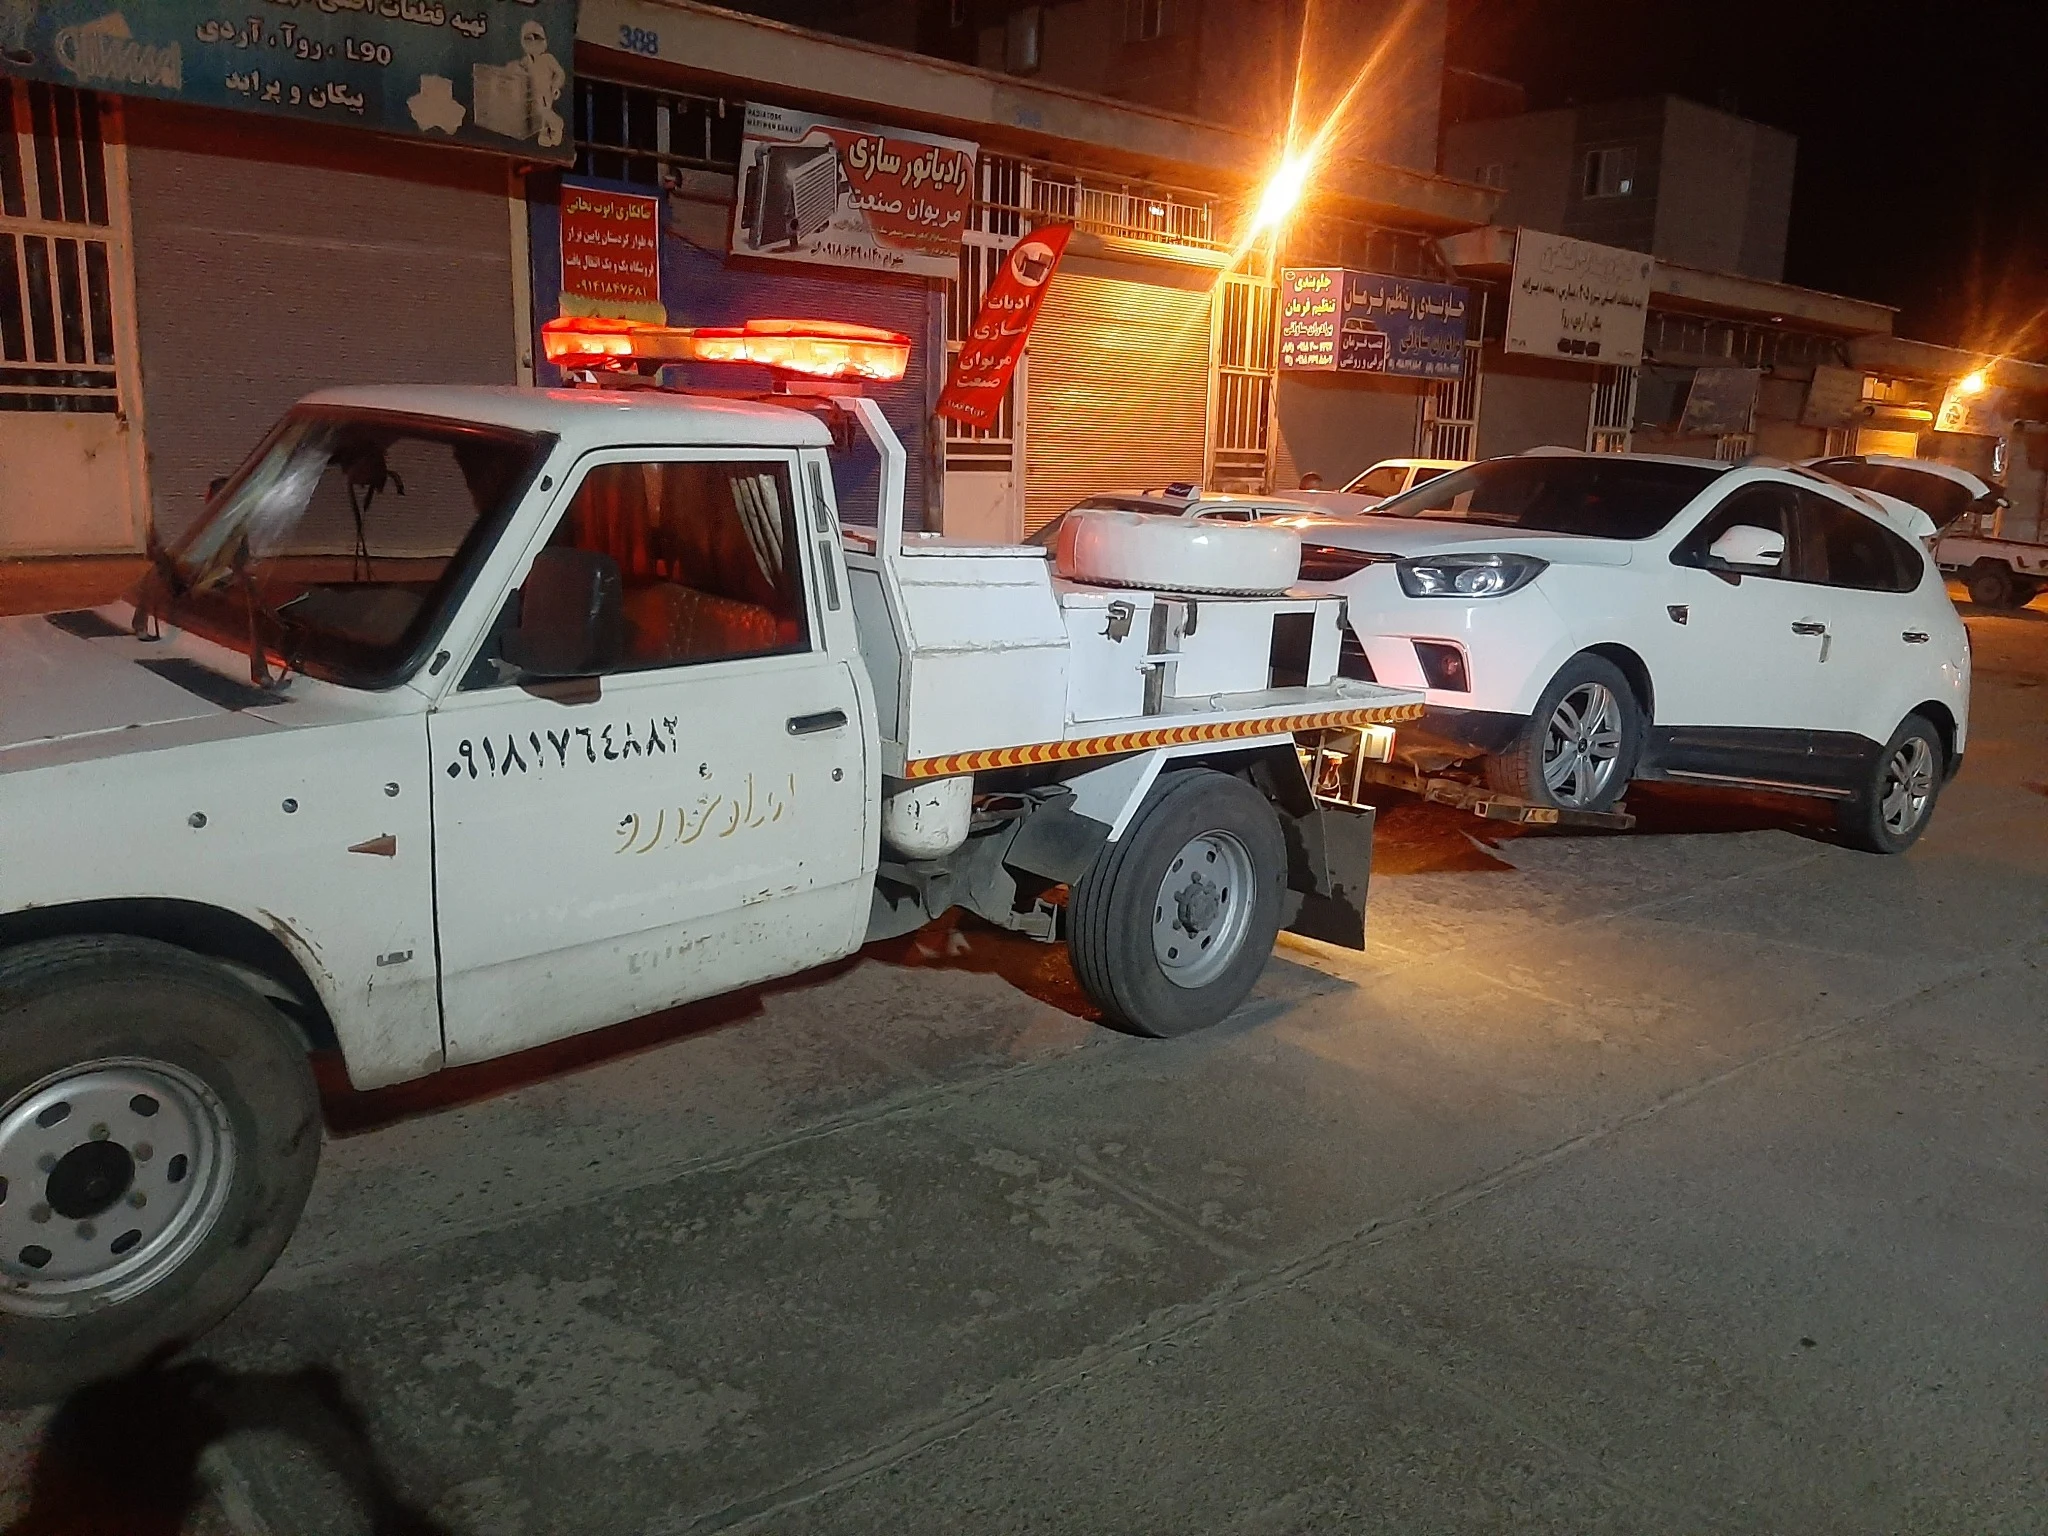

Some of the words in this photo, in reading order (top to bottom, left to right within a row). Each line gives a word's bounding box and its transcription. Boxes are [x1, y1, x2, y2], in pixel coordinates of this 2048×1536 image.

[450, 12, 489, 38] تهیه
[225, 69, 281, 104] پراید
[289, 85, 301, 105] و
[308, 81, 365, 115] پیکان
[849, 136, 901, 181] سازی
[901, 147, 968, 196] رادیاتور
[848, 188, 903, 214] صنعت
[906, 198, 962, 228] مریوان
[1294, 272, 1332, 293] جلوبندی
[1285, 296, 1311, 318] فرمان
[1311, 297, 1336, 317] تنظیم
[1343, 277, 1384, 315] فرمان
[973, 320, 1028, 340] سازی
[959, 351, 1012, 371] مریوان
[956, 375, 1001, 388] صنعت
